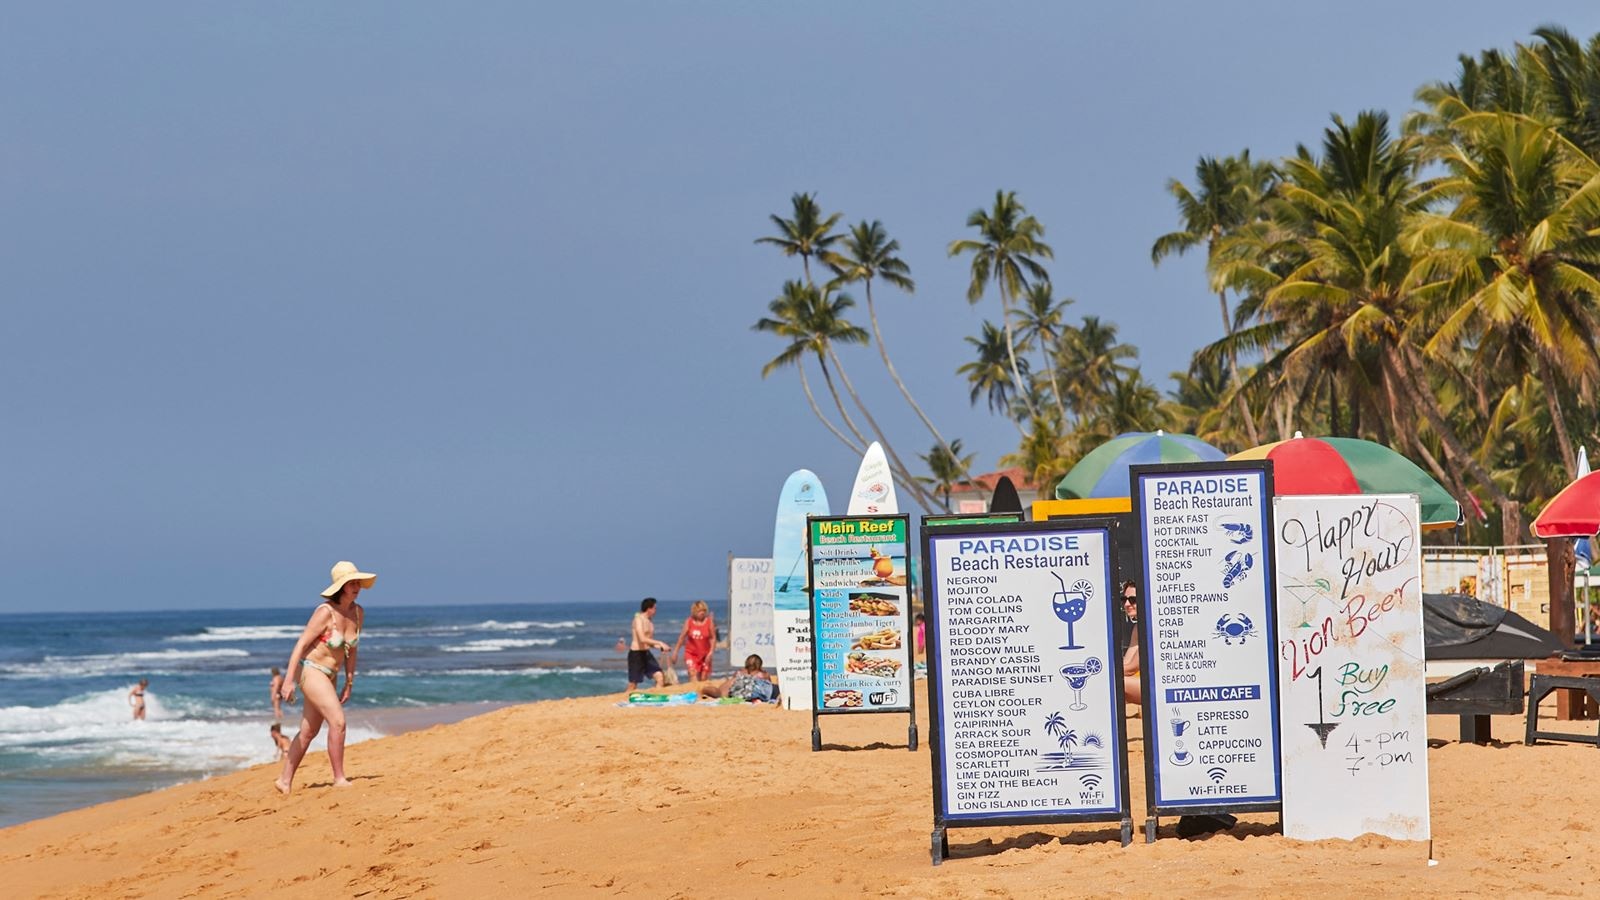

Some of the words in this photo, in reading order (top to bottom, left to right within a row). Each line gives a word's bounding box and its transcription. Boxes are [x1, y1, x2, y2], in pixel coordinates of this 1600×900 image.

[1157, 478, 1248, 496] PARADISE
[1154, 497, 1188, 510] Beach
[1192, 495, 1252, 508] Restaurant
[1154, 515, 1184, 525] BREAK
[1187, 514, 1208, 523] FAST
[820, 521, 855, 534] Main
[860, 520, 895, 533] Reef
[1154, 527, 1172, 536] HOT
[1175, 525, 1208, 535] DRINKS
[820, 535, 847, 544] Beach
[848, 534, 897, 543] Restaurant
[1282, 499, 1379, 573] Happy
[960, 536, 1079, 555] PARADISE
[1155, 538, 1199, 547] COCKTAIL
[835, 548, 858, 556] Drinks
[1155, 550, 1184, 559] FRESH
[1187, 548, 1212, 557] FRUIT
[837, 558, 860, 567] Drinks
[951, 555, 999, 571] Beach
[1005, 552, 1089, 569] Restaurant
[1156, 560, 1192, 570] SNACKS
[841, 569, 859, 577] Fruit
[1340, 535, 1411, 601] Hour
[947, 576, 997, 585] NEGRONI
[1156, 572, 1181, 581] SOUP
[947, 586, 988, 595] MOJITO
[1157, 583, 1195, 593] JAFFLES
[821, 590, 843, 598] Salads
[1157, 594, 1188, 605] JUMBO
[1191, 593, 1229, 603] PRAWNS
[948, 597, 973, 605] PINA
[976, 595, 1022, 604] COLADA
[821, 602, 842, 610] Soups
[948, 607, 971, 615] TOM
[975, 605, 1022, 614] COLLINS
[1158, 606, 1199, 616] LOBSTER
[949, 616, 1014, 625] MARGARITA
[1159, 618, 1184, 627] CRAB
[787, 626, 811, 634] Pad
[949, 626, 995, 636] BLOODY
[999, 625, 1029, 633] MARY
[1159, 630, 1179, 638] FISH
[1281, 617, 1340, 682] Lion
[1340, 576, 1420, 638] Beer
[950, 638, 972, 646] RED
[976, 636, 1008, 645] DAISY
[1160, 640, 1206, 650] CALAMARI
[950, 647, 1001, 656] MOSCOW
[1005, 645, 1035, 653] MULE
[823, 652, 838, 660] Beef
[951, 657, 996, 666] BRANDY
[1000, 655, 1040, 664] CASSIS
[1160, 652, 1172, 661] SRI
[1174, 651, 1203, 660] LANKAN
[823, 662, 838, 670] Fish
[1166, 661, 1183, 670] RICE
[1185, 661, 1190, 670] &
[1192, 660, 1216, 669] CURRY
[952, 667, 992, 676] MANGO
[996, 665, 1040, 674] MARTINI
[824, 672, 850, 680] Lobster
[952, 677, 1006, 686] PARADISE
[1010, 675, 1053, 684] SUNSET
[1162, 674, 1196, 684] SEAFOOD
[1334, 662, 1389, 694] Buy
[859, 679, 874, 687] Rice
[883, 679, 902, 688] curry
[953, 690, 982, 698] CUBA
[985, 689, 1015, 697] LIBRE
[1174, 689, 1218, 701] ITALIAN
[1221, 687, 1253, 699] CAFE
[953, 700, 995, 708] CEYLON
[999, 698, 1042, 707] COOLER
[953, 710, 994, 718] WHISKY
[997, 709, 1026, 717] SOUR
[1197, 710, 1249, 721] ESPRESSO
[954, 719, 1013, 729] CAIPIRINHA
[955, 730, 998, 739] ARRACK
[1002, 729, 1031, 737] SOUR
[1198, 725, 1227, 735] LATTE
[955, 741, 976, 749] SEA
[979, 739, 1019, 748] BREEZE
[1199, 738, 1262, 750] CAPPUCCINO
[955, 749, 1038, 759] COSMOPOLITAN
[1200, 755, 1215, 764] ICE
[1218, 753, 1256, 764] COFFEE
[956, 760, 1010, 769] SCARLETT
[957, 771, 980, 780] LIME
[984, 769, 1029, 778] DAIQUIRI
[957, 782, 977, 790] SEX
[980, 781, 995, 789] ON
[998, 780, 1018, 788] THE
[1022, 778, 1057, 787] BEACH
[1079, 791, 1104, 799] Wi-Fi
[1189, 786, 1216, 795] Wi-Fi
[1219, 785, 1247, 794] FREE
[957, 792, 975, 800] GIN
[978, 791, 1000, 799] FIZZ
[958, 801, 987, 810] LONG
[990, 800, 1028, 808] ISLAND
[1051, 798, 1071, 806] TEA
